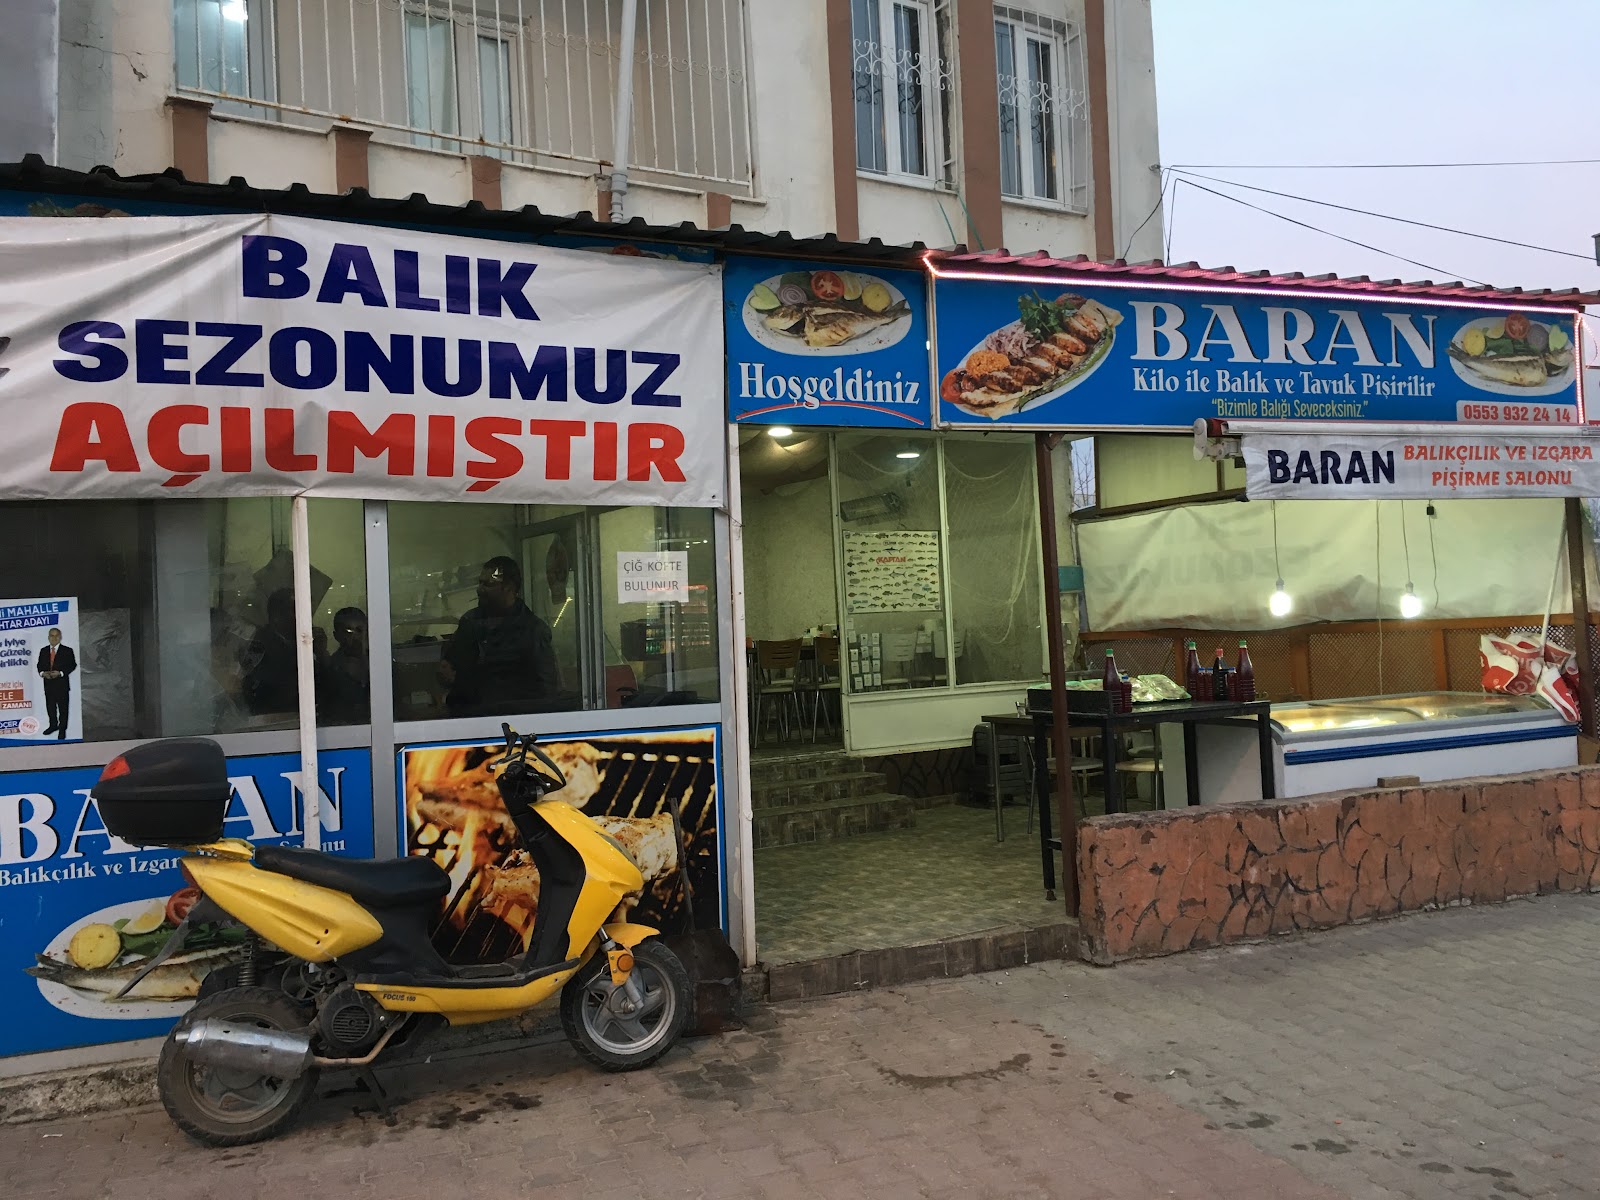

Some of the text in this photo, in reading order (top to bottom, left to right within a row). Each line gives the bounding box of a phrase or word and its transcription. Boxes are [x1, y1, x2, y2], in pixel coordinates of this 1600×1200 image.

[242, 235, 541, 321] BALIK
[1128, 301, 1440, 370] BARAN
[53, 319, 681, 408] SEZONUMUZ
[738, 362, 920, 410] Hoşgeldiniz
[1132, 367, 1436, 399] Kilo ile Balık ve Tavuk Pişirilir
[1261, 398, 1291, 420] Balığı
[1463, 404, 1571, 422] 0553 932 24 14
[49, 401, 687, 492] AÇILMIŞTIR
[1403, 445, 1594, 465] BALIKÇILIK VE IZGARA
[1267, 449, 1395, 485] BARAN
[1431, 467, 1573, 490] PİŞİRME SALONU
[623, 559, 682, 574] ÇİĞ KÖFTE
[624, 580, 679, 592] BULUNUR
[7, 603, 59, 617] MAHALLE
[24, 616, 50, 627] ADAYI
[0, 658, 29, 668] irlikte
[2, 701, 32, 709] ZAMANI
[0, 767, 349, 865] BAAN
[0, 856, 183, 887] Balıkçılık ve Izgar
[382, 993, 405, 1001] FOCUS
